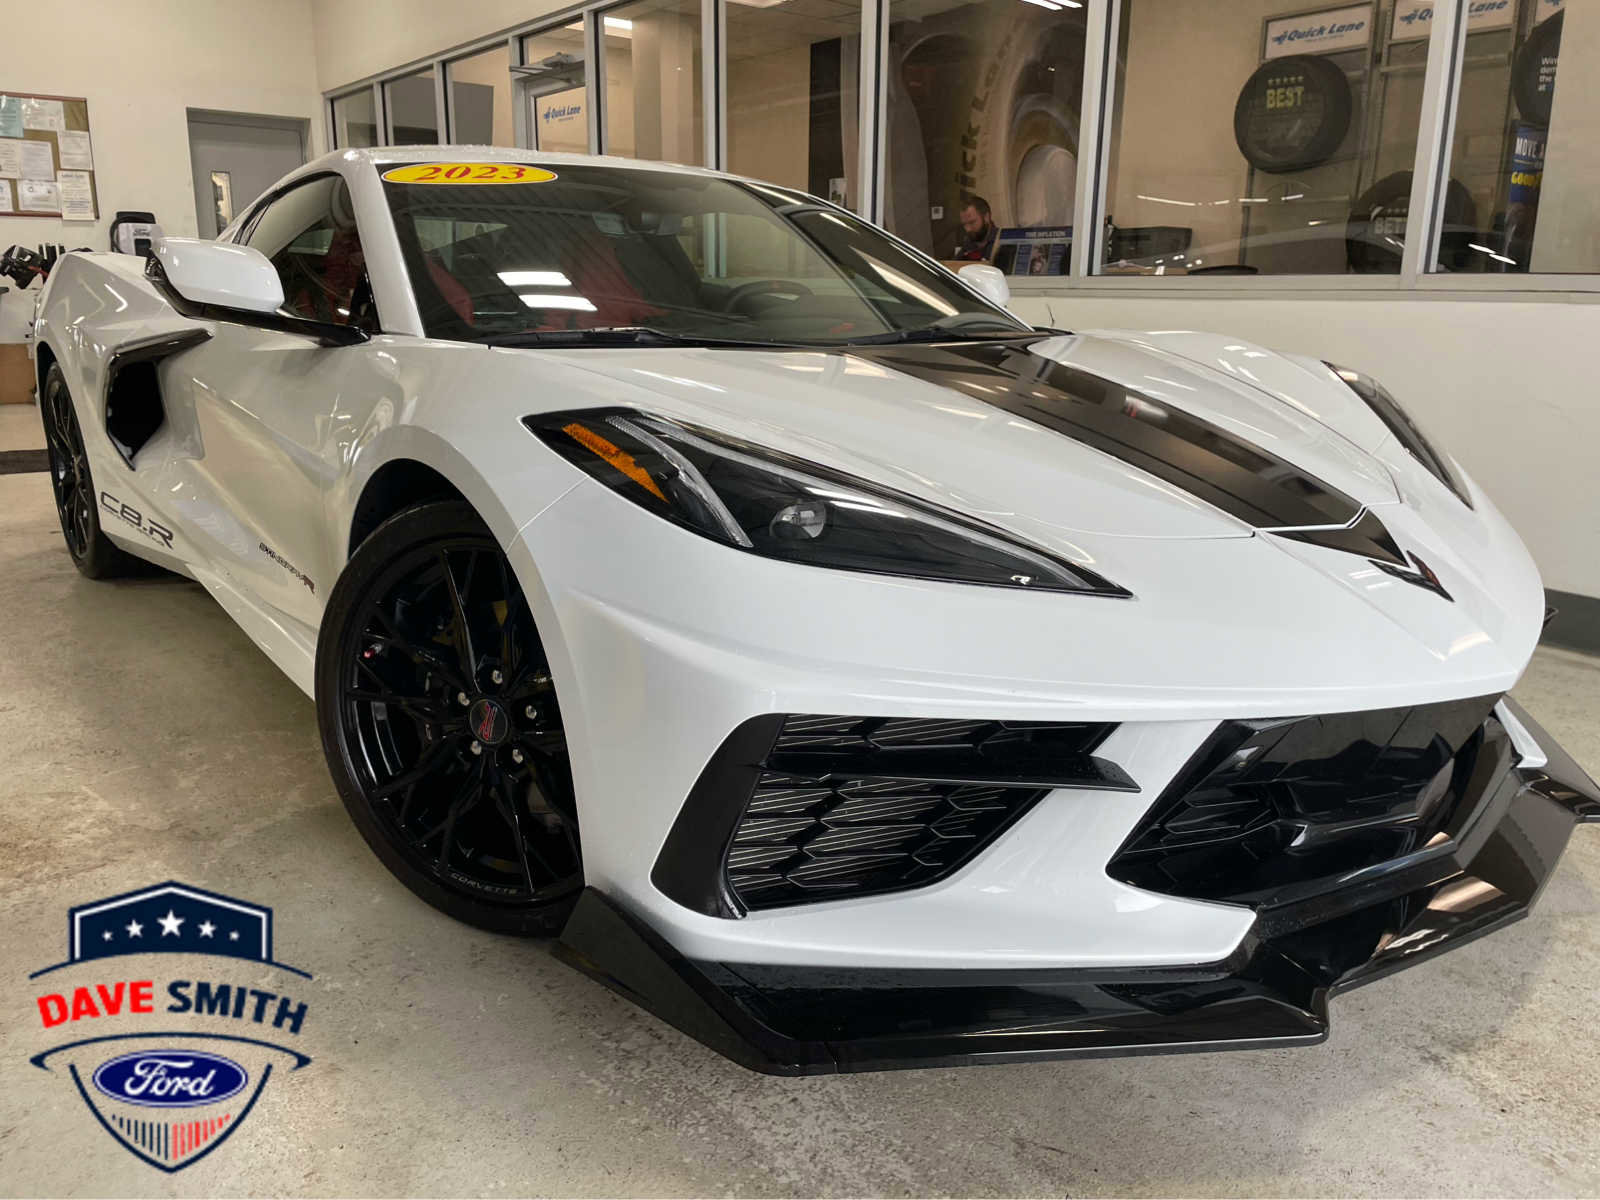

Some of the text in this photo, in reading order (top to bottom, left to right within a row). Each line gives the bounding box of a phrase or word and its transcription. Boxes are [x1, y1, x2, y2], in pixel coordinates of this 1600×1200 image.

[1287, 25, 1327, 41] Quick
[1328, 22, 1365, 34] Lane
[1266, 86, 1304, 109] BEST
[1515, 137, 1537, 158] MOVE
[415, 166, 527, 181] 2023
[101, 491, 174, 550] C8.R
